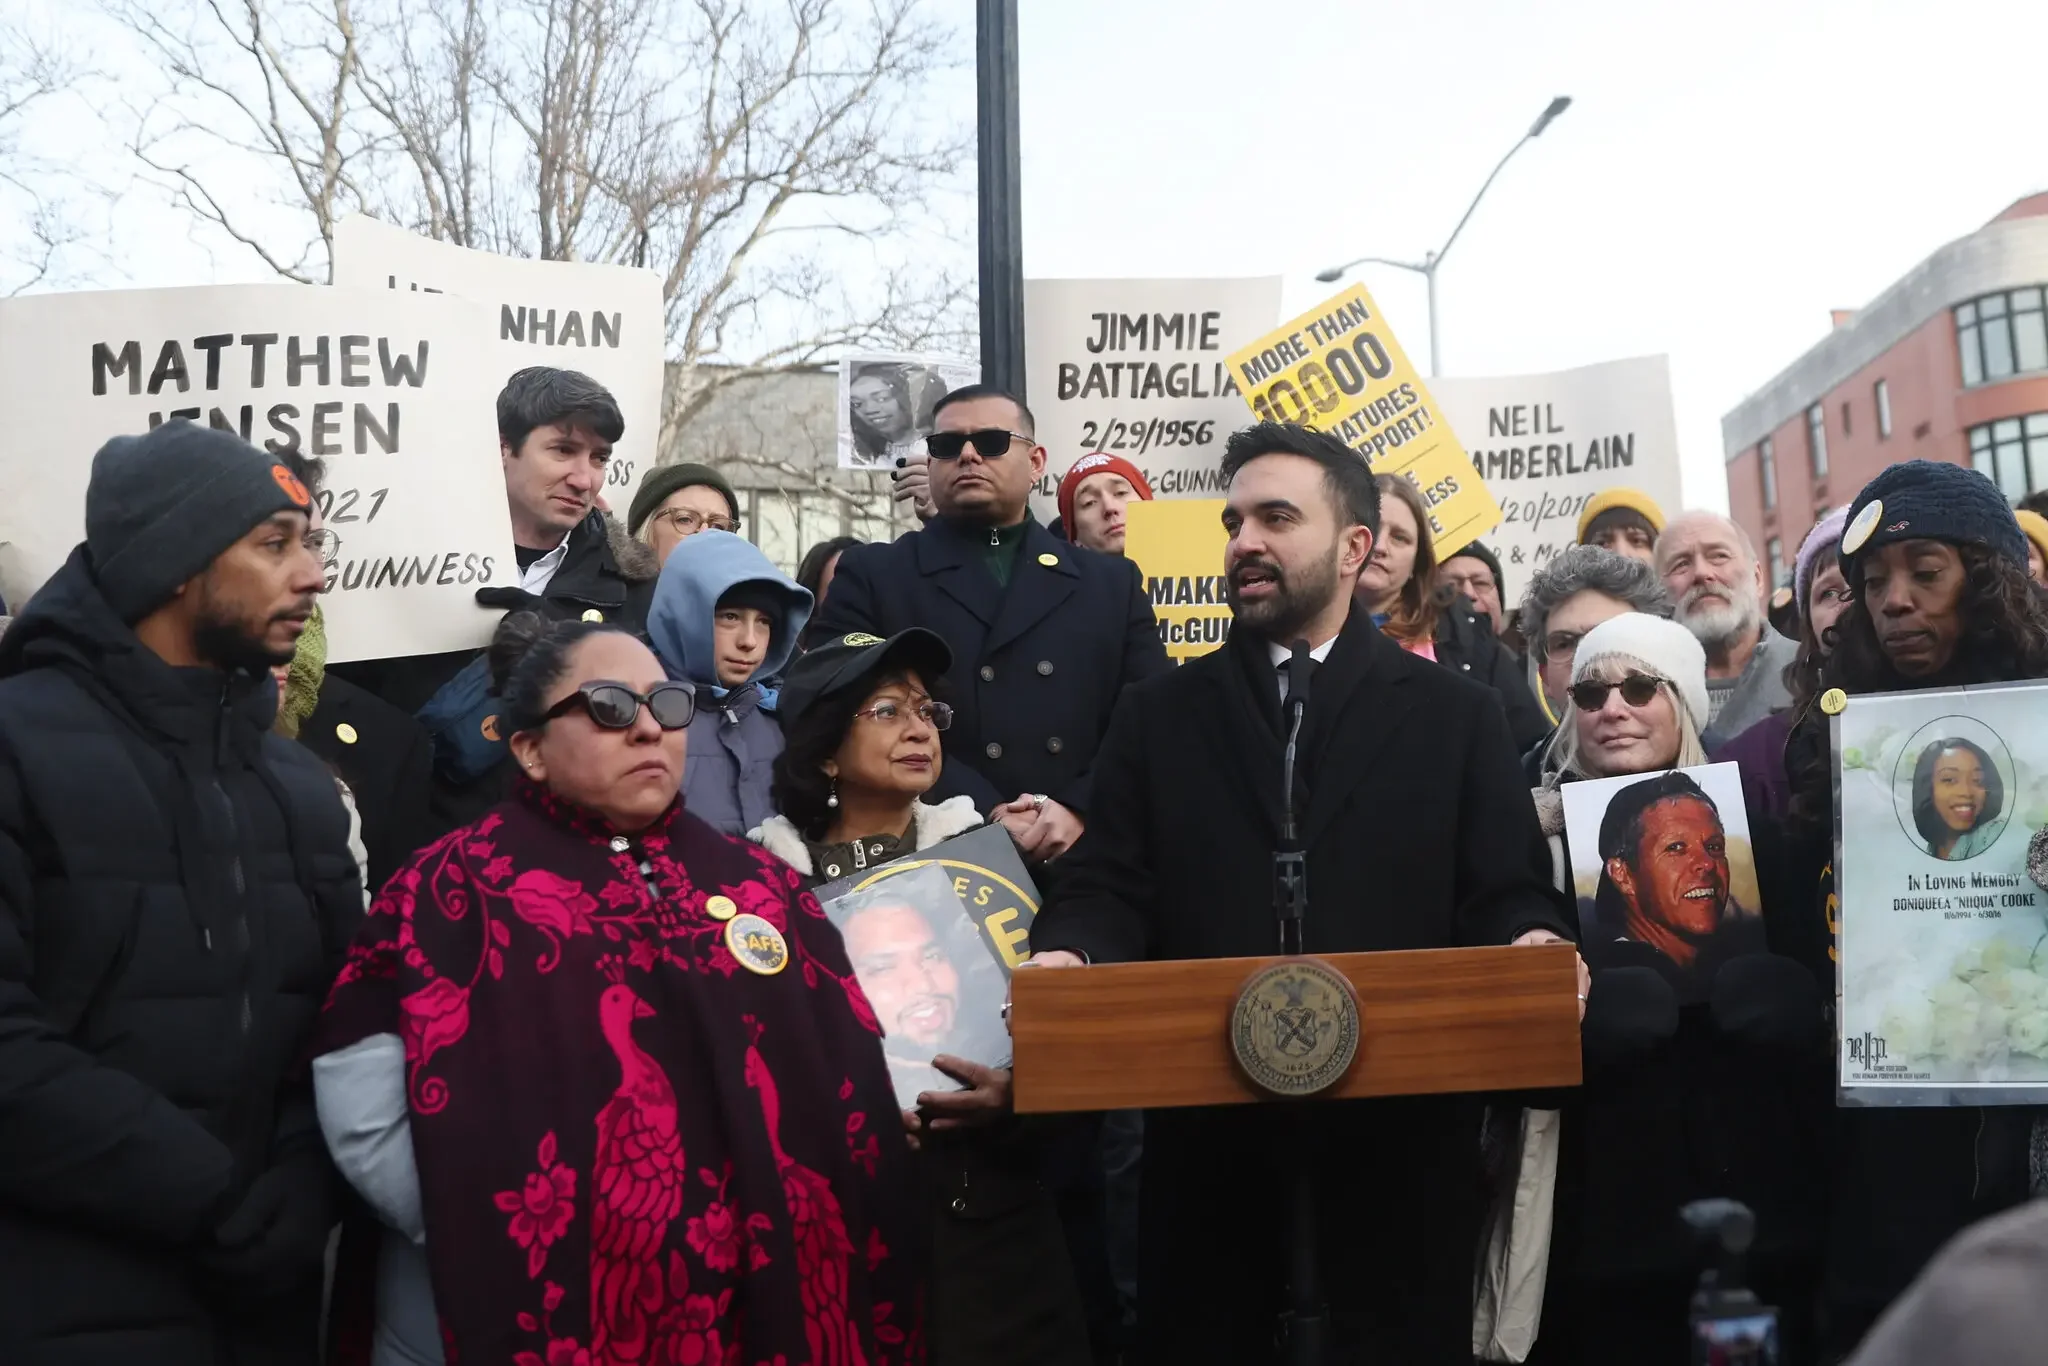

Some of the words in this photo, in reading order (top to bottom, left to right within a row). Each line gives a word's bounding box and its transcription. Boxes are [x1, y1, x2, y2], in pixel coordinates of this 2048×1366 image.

[501, 304, 622, 348] NHAN
[1087, 312, 1220, 353] JIMMIE
[1240, 332, 1311, 386] MORE
[1305, 297, 1370, 346] THAN
[92, 333, 429, 395] MATTHEW
[1327, 383, 1418, 445] NATURES
[1356, 405, 1434, 464] PPORT!
[1489, 403, 1564, 437] NEIL
[1080, 417, 1215, 455] 2/29/1956
[1472, 433, 1634, 480] AMBERLAIN
[322, 552, 495, 595] GUINNESS
[1926, 873, 1966, 890] LOVING
[2001, 893, 2036, 907] COOKE
